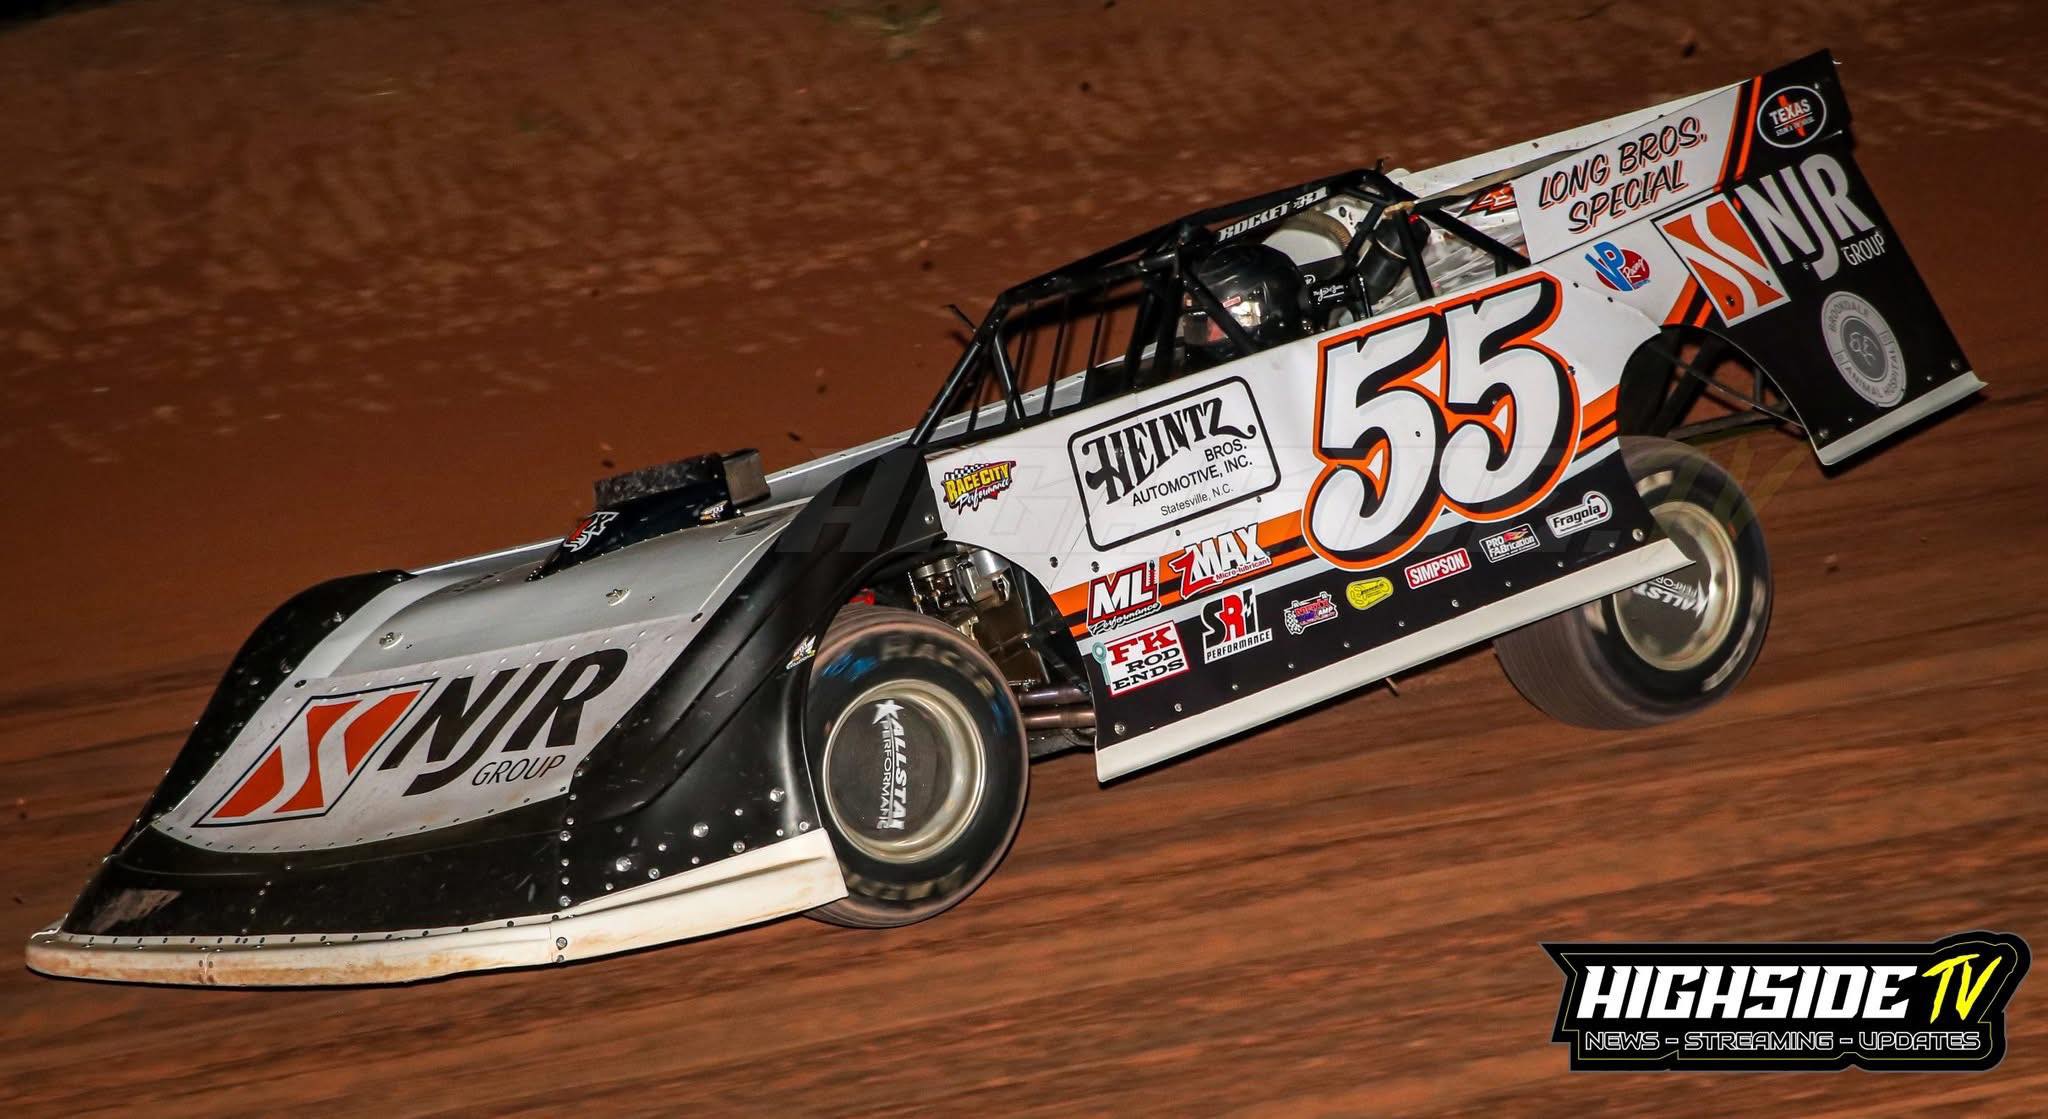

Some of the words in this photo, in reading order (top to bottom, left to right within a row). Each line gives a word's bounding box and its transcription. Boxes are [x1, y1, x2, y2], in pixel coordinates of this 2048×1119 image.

[1769, 99, 1811, 126] TEXAS
[1538, 153, 1609, 208] LONG
[1617, 116, 1707, 176] BROS.
[1568, 159, 1689, 234] SPECIAL
[1218, 201, 1290, 242] ROCKET
[1734, 153, 1881, 281] NJR
[1585, 241, 1633, 292] VP
[1841, 231, 1886, 267] GROUP
[1302, 270, 1582, 572] 55
[1081, 397, 1257, 505] HEINTZ
[1205, 438, 1247, 463] BROS.
[1132, 465, 1223, 507] AUTOMOTIVE,
[1225, 455, 1253, 475] INC.
[1160, 491, 1211, 517] Statesville,
[1213, 484, 1234, 499] N.C.
[1552, 503, 1600, 528] Fragola
[1485, 535, 1504, 550] PRO
[1409, 553, 1467, 587] SIMPSON
[1090, 602, 1162, 636] Performance
[1107, 625, 1177, 666] FK
[1126, 647, 1180, 674] ROD
[1206, 631, 1271, 662] PERFORMANCE
[1112, 656, 1186, 692] ENDS
[377, 648, 628, 797] NJR
[471, 754, 566, 787] GROUP
